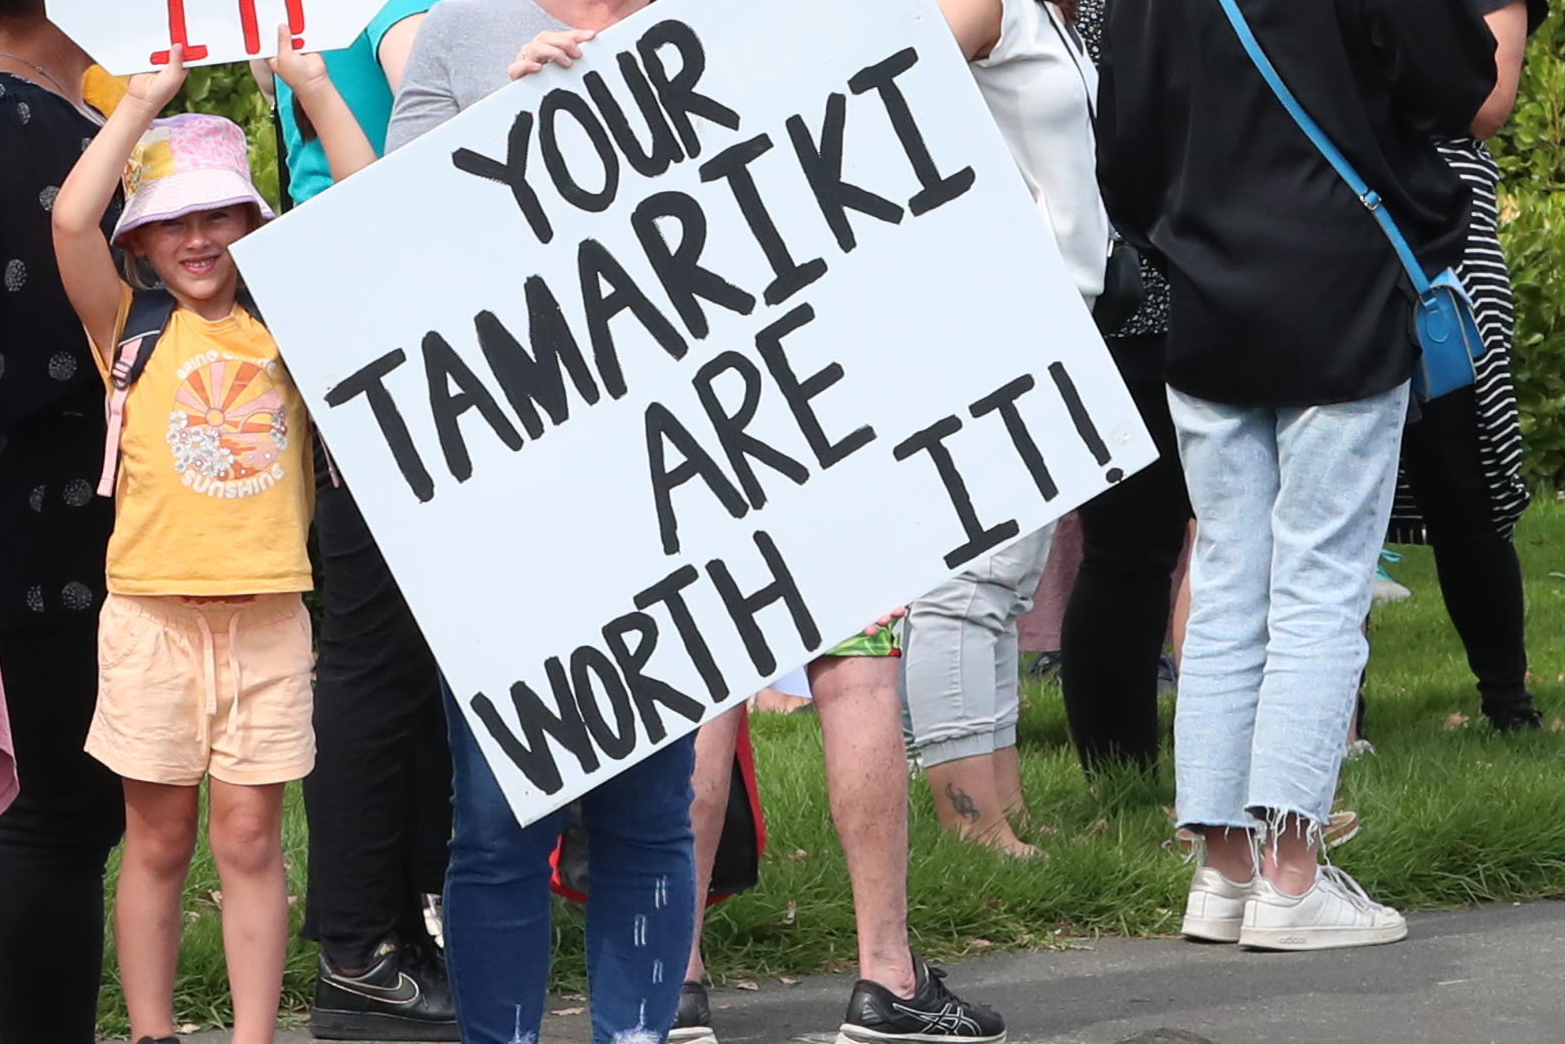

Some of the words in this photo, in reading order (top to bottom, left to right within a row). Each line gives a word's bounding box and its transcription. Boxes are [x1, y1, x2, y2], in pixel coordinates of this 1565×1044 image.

[325, 47, 976, 503] TAMARIKI
[452, 19, 740, 244] YOUR
[470, 530, 822, 796] WORTH
[893, 361, 1124, 570] IT!
[645, 302, 877, 556] ARE
